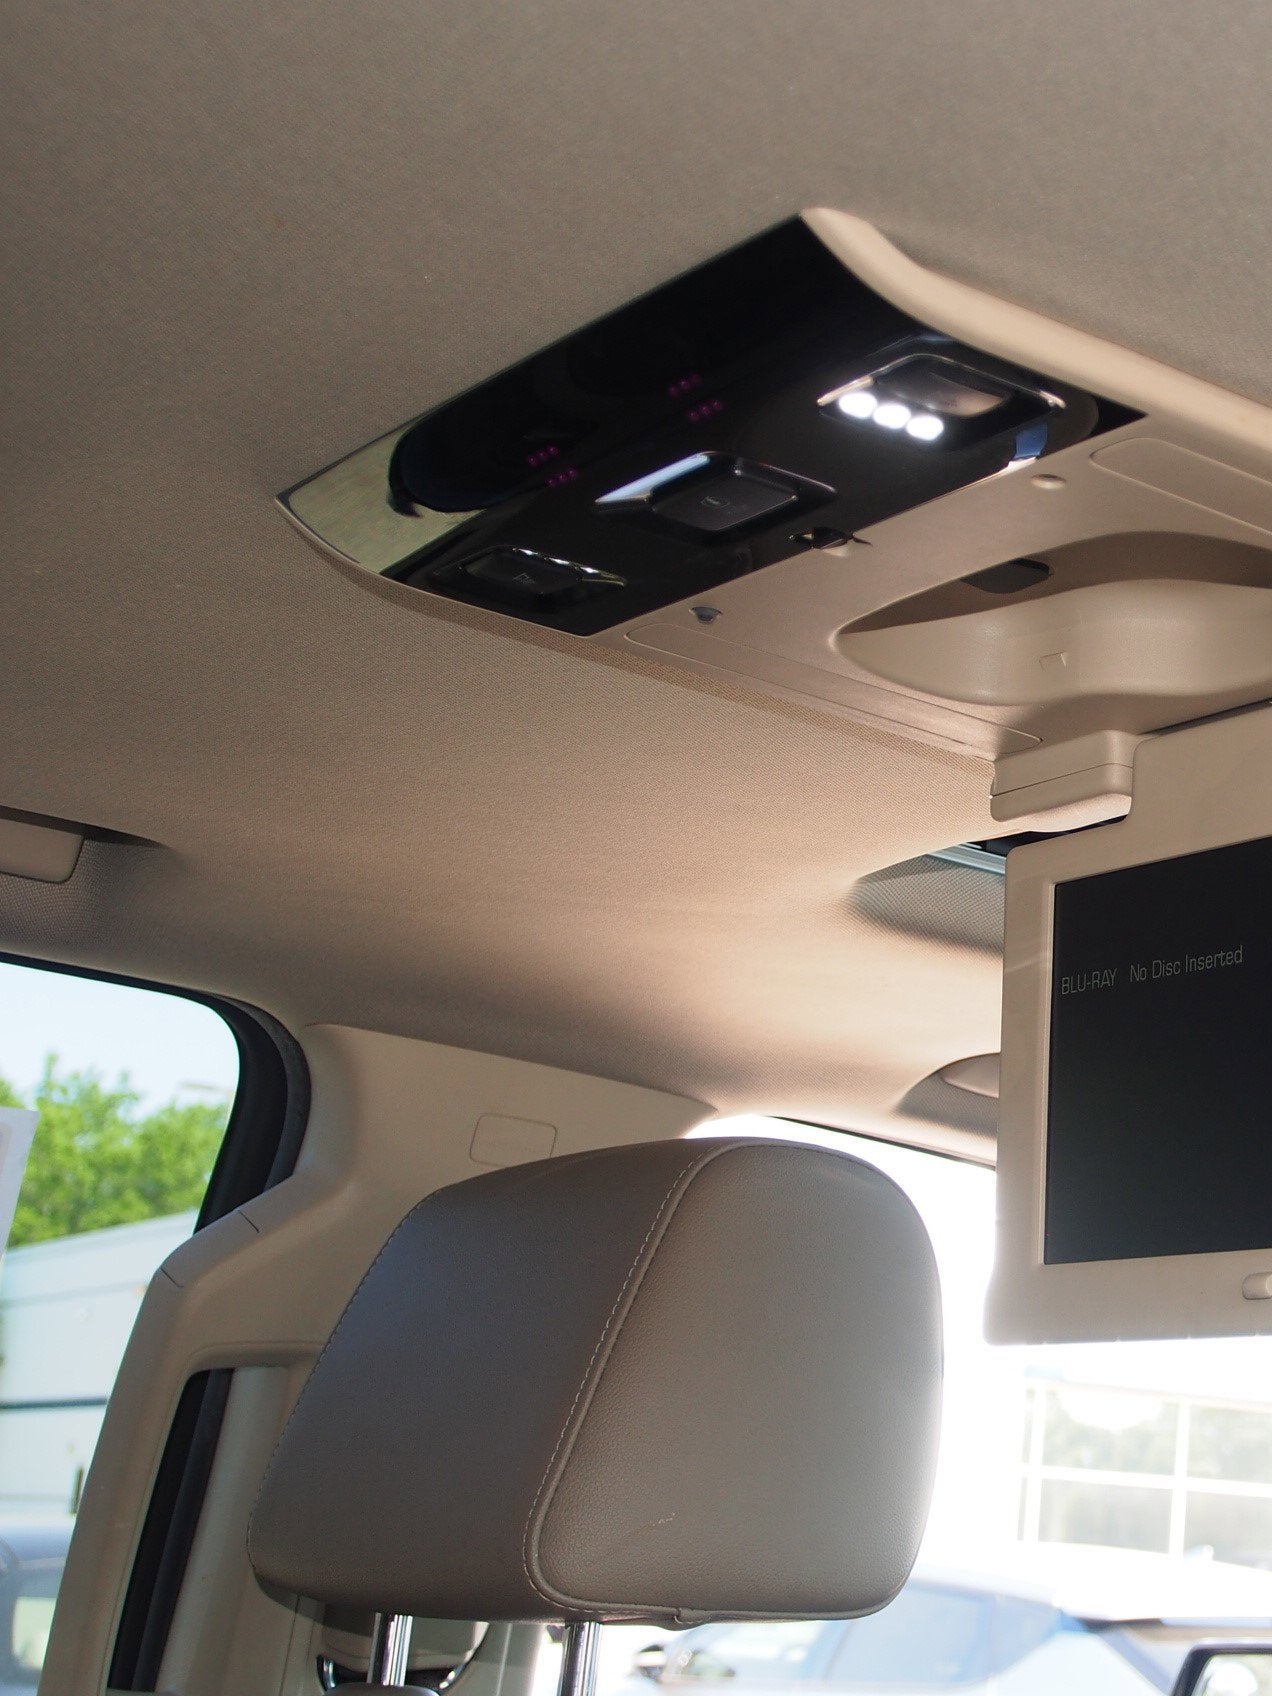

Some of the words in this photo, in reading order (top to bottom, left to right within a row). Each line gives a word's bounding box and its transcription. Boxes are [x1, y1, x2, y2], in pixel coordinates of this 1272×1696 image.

[1061, 968, 1118, 995] BLU-RAY
[1129, 964, 1147, 982] No
[1152, 960, 1181, 979] Disc
[1185, 945, 1244, 973] Inserted
